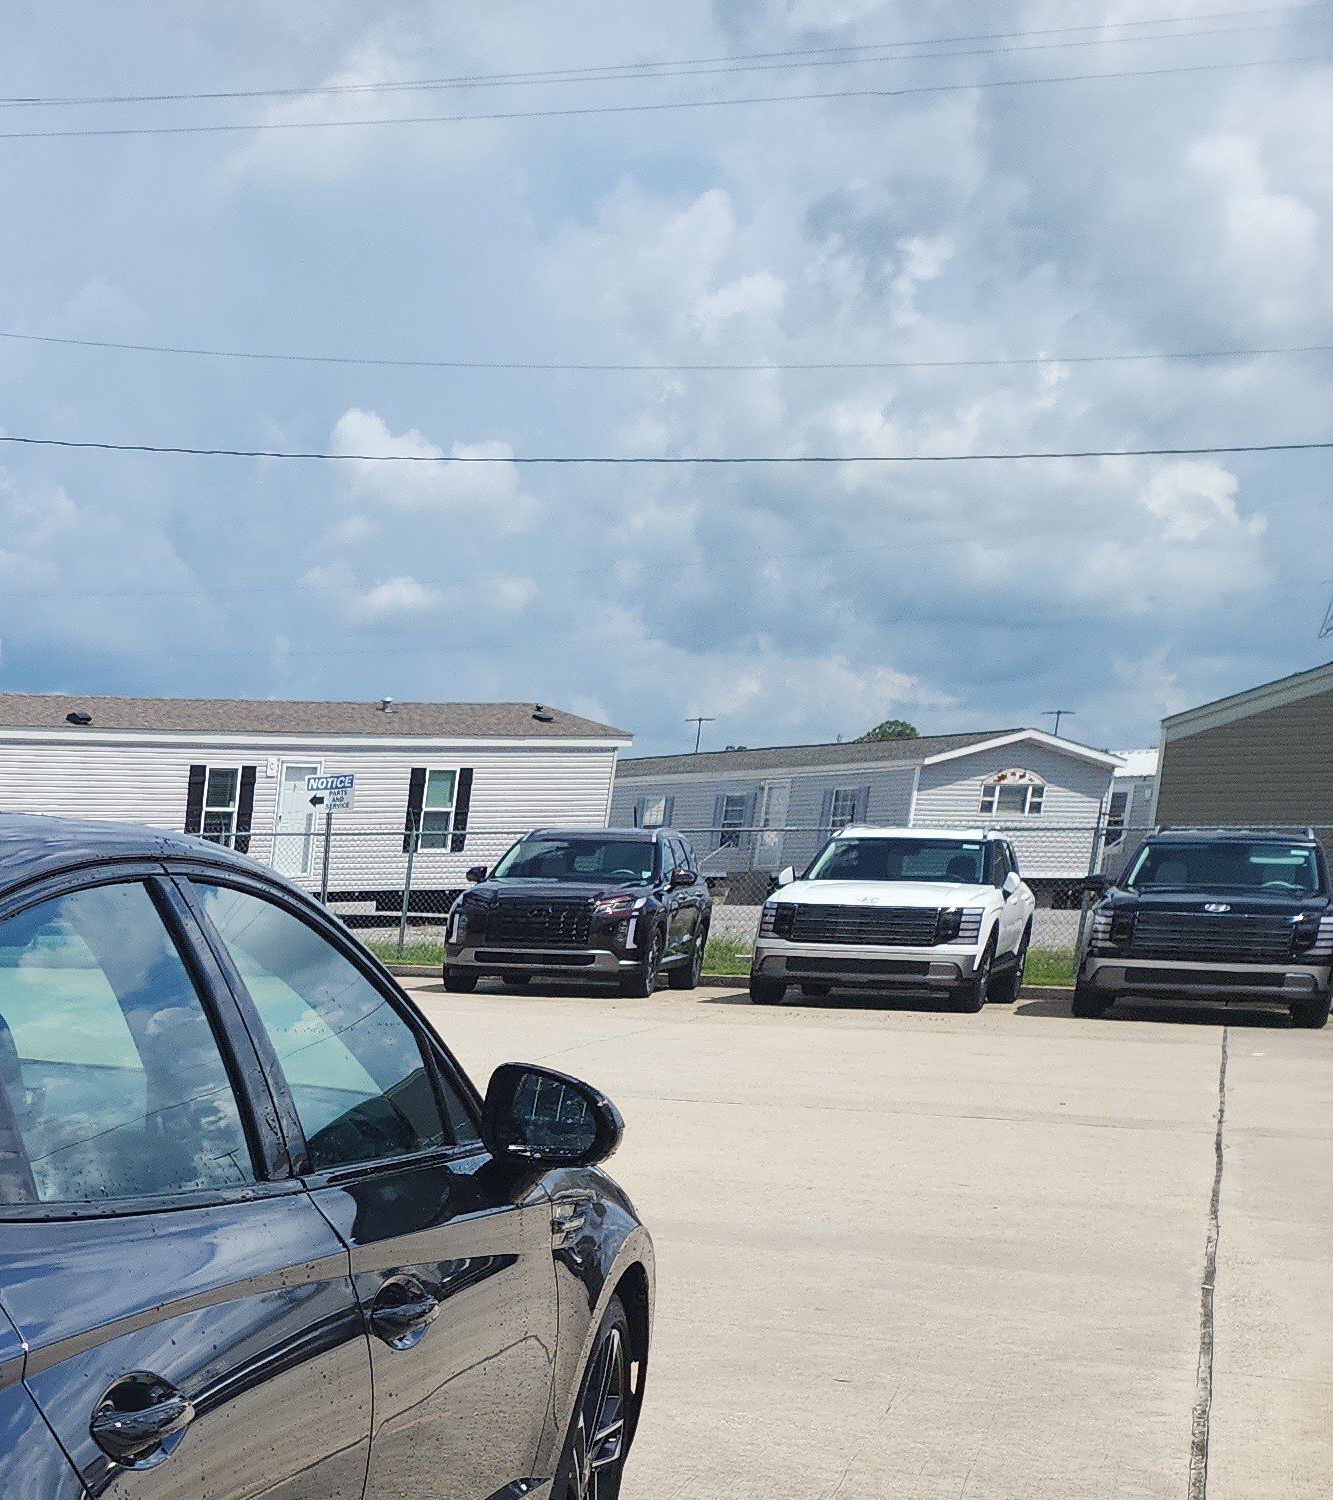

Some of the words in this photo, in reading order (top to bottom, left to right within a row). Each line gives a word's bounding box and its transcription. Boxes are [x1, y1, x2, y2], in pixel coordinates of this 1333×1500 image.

[308, 776, 353, 790] NOTICE
[328, 789, 348, 797] PARTS
[325, 802, 350, 810] SERVICE
